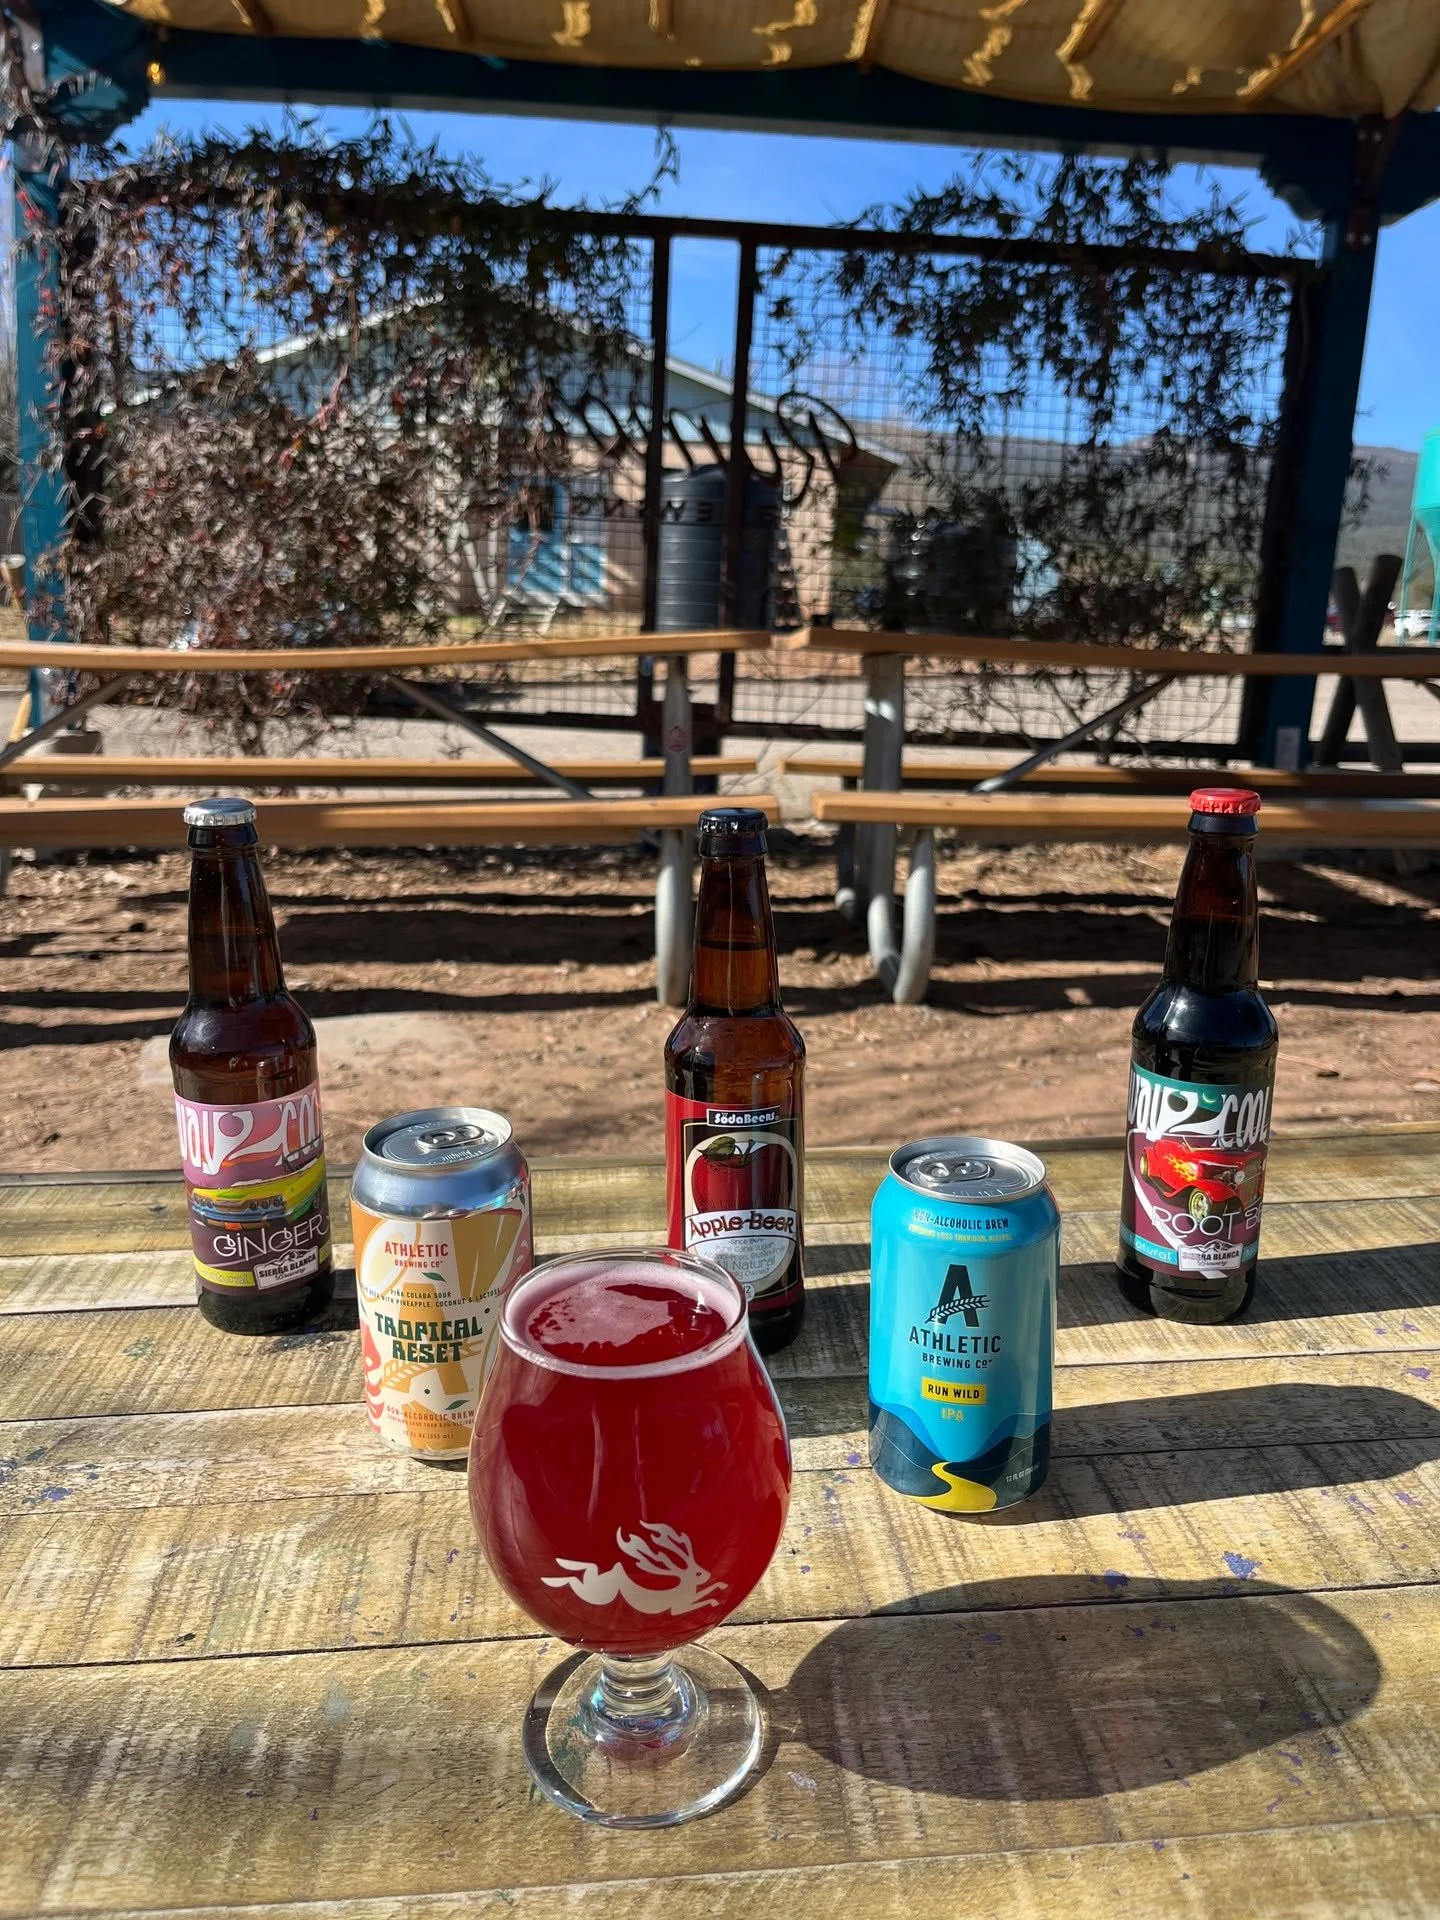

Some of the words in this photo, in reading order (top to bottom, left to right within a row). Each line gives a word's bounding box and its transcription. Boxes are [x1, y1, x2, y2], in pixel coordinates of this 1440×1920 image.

[914, 1208, 981, 1230] NON-ALCOHOLIC
[985, 1217, 1009, 1230] BREW
[1152, 1205, 1240, 1240] ROOT
[213, 1214, 329, 1261] GINGER
[385, 1240, 449, 1258] ATHLETIC
[1183, 1252, 1211, 1262] SIERRA
[1213, 1249, 1239, 1261] BLANCA
[259, 1264, 289, 1278] SIERRA
[290, 1253, 316, 1270] BLANCA
[395, 1259, 428, 1268] BREWING
[732, 1255, 775, 1271] Natural
[406, 1291, 431, 1299] COLADA
[433, 1291, 451, 1299] SOUR
[435, 1297, 466, 1308] COCONUT
[375, 1311, 483, 1342] TROPICAL
[909, 1325, 1001, 1354] ATHLETIC
[392, 1339, 463, 1364] RESET
[922, 1353, 971, 1369] BREWING
[928, 1384, 949, 1397] RUN
[953, 1388, 980, 1399] WILD
[387, 1404, 448, 1421] NON-ALCOHOLIC
[451, 1409, 475, 1421] BREW
[941, 1407, 964, 1421] IPA
